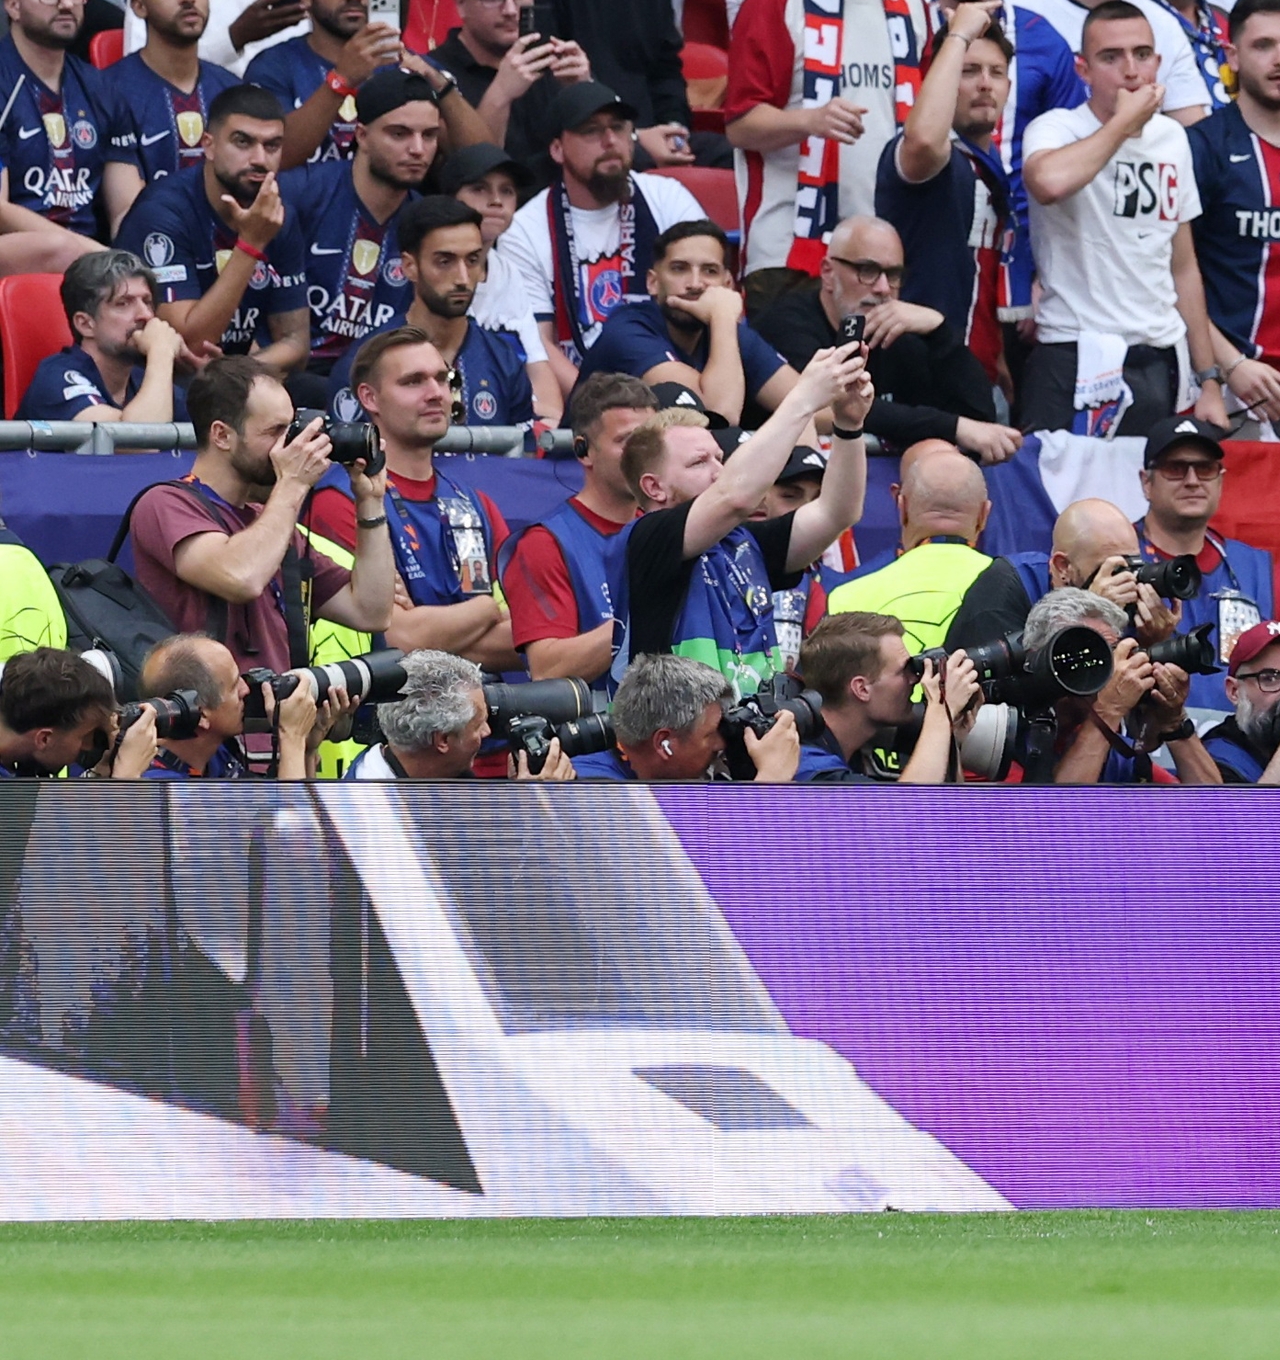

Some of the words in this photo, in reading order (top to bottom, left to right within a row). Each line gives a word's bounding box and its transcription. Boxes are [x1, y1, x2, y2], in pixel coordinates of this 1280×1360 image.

[841, 62, 893, 90] HOMS
[1113, 161, 1179, 221] PSG
[621, 203, 636, 277] PARIS
[306, 284, 394, 329] QATAR
[320, 318, 374, 346] AIRWA
